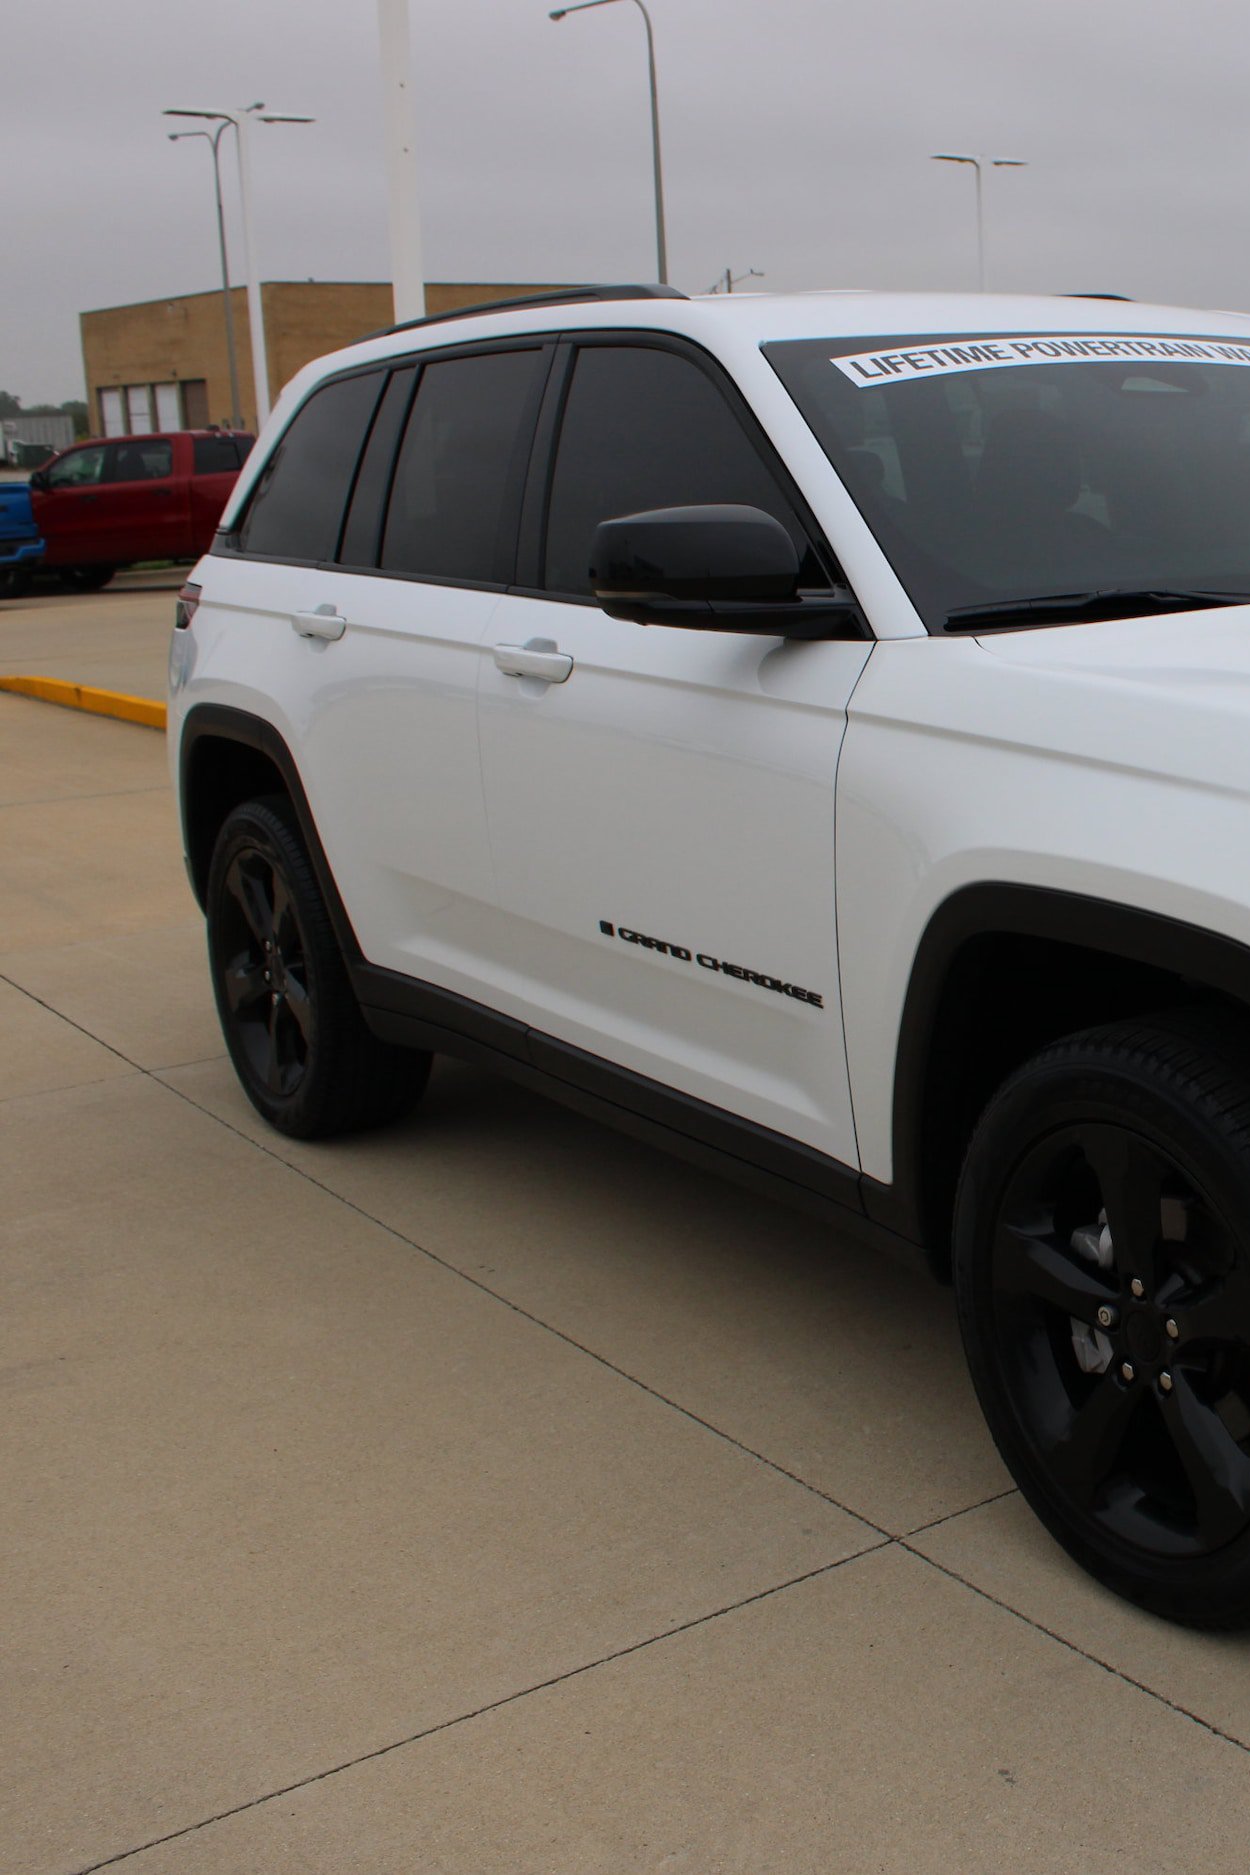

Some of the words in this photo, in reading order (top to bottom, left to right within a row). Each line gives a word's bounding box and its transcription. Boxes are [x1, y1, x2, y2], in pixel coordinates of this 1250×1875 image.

[849, 343, 1015, 380] LIFETIME
[1010, 339, 1216, 359] POWERTRAIN
[617, 926, 693, 963] GRAND
[696, 953, 825, 1010] CHEROKEE
